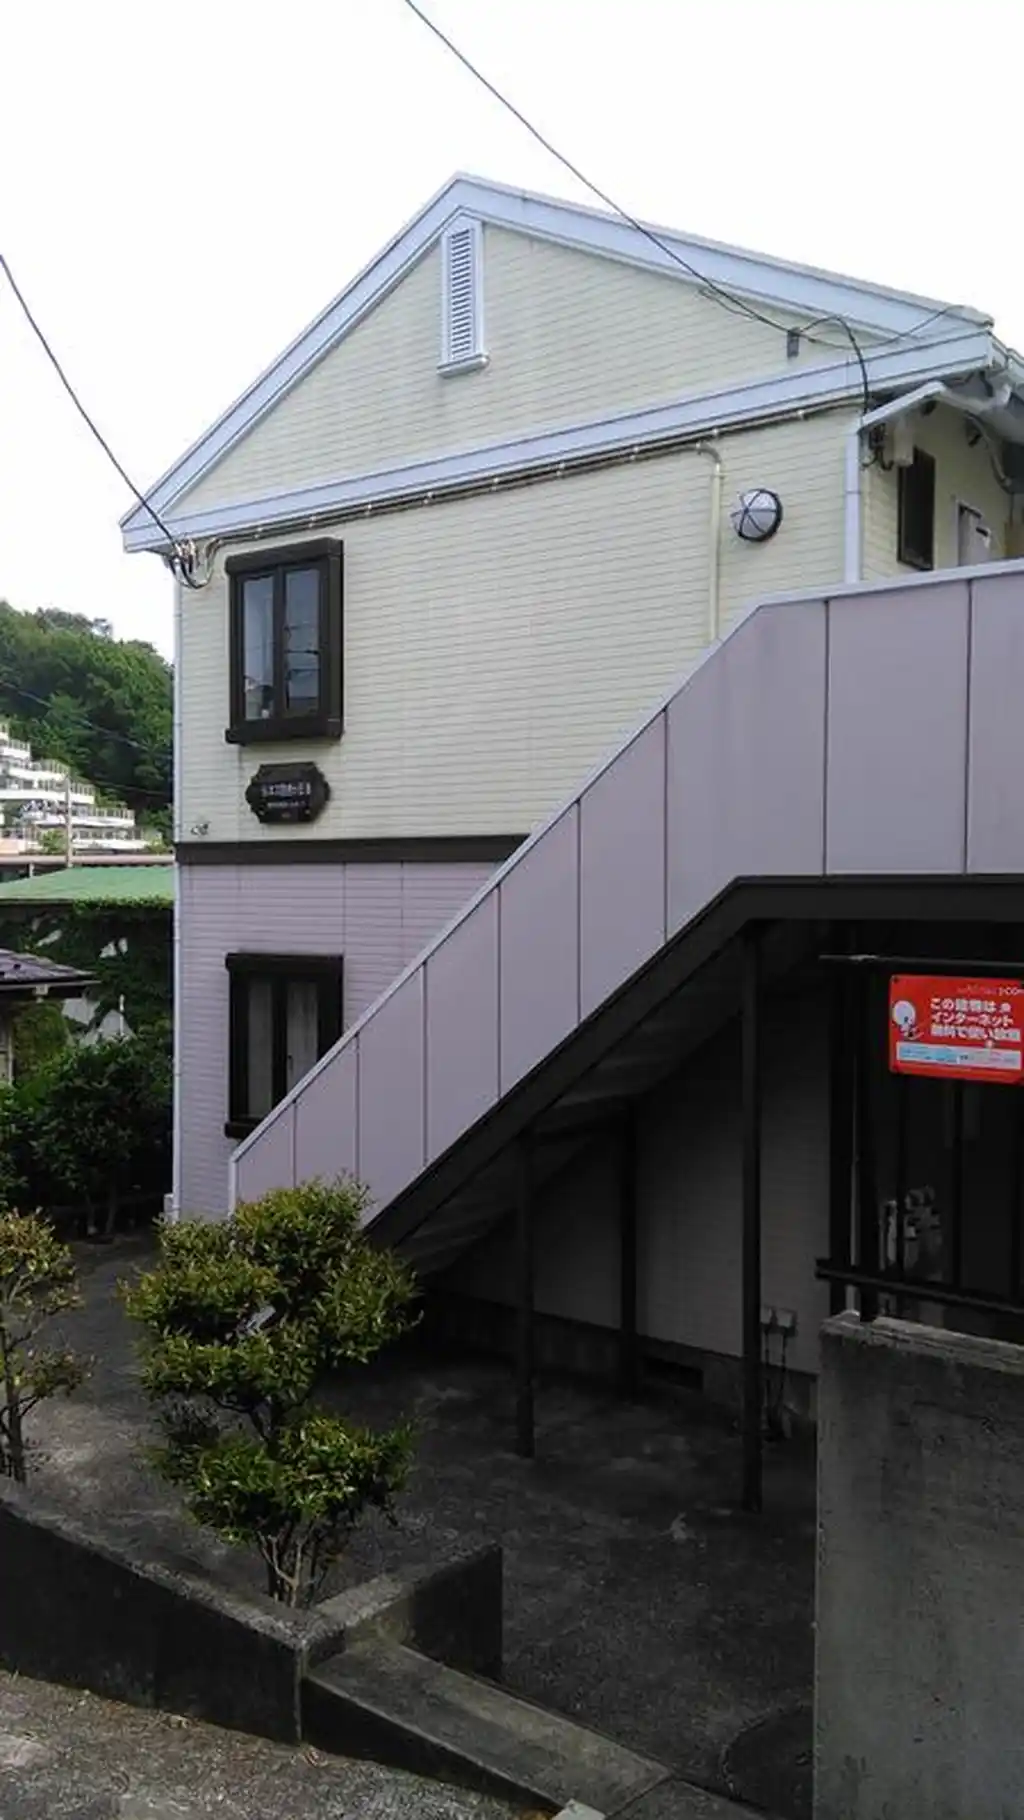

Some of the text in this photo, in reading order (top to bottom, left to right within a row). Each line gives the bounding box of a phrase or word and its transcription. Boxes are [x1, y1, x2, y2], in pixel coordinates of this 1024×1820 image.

[930, 1011, 1014, 1027] インターネット
